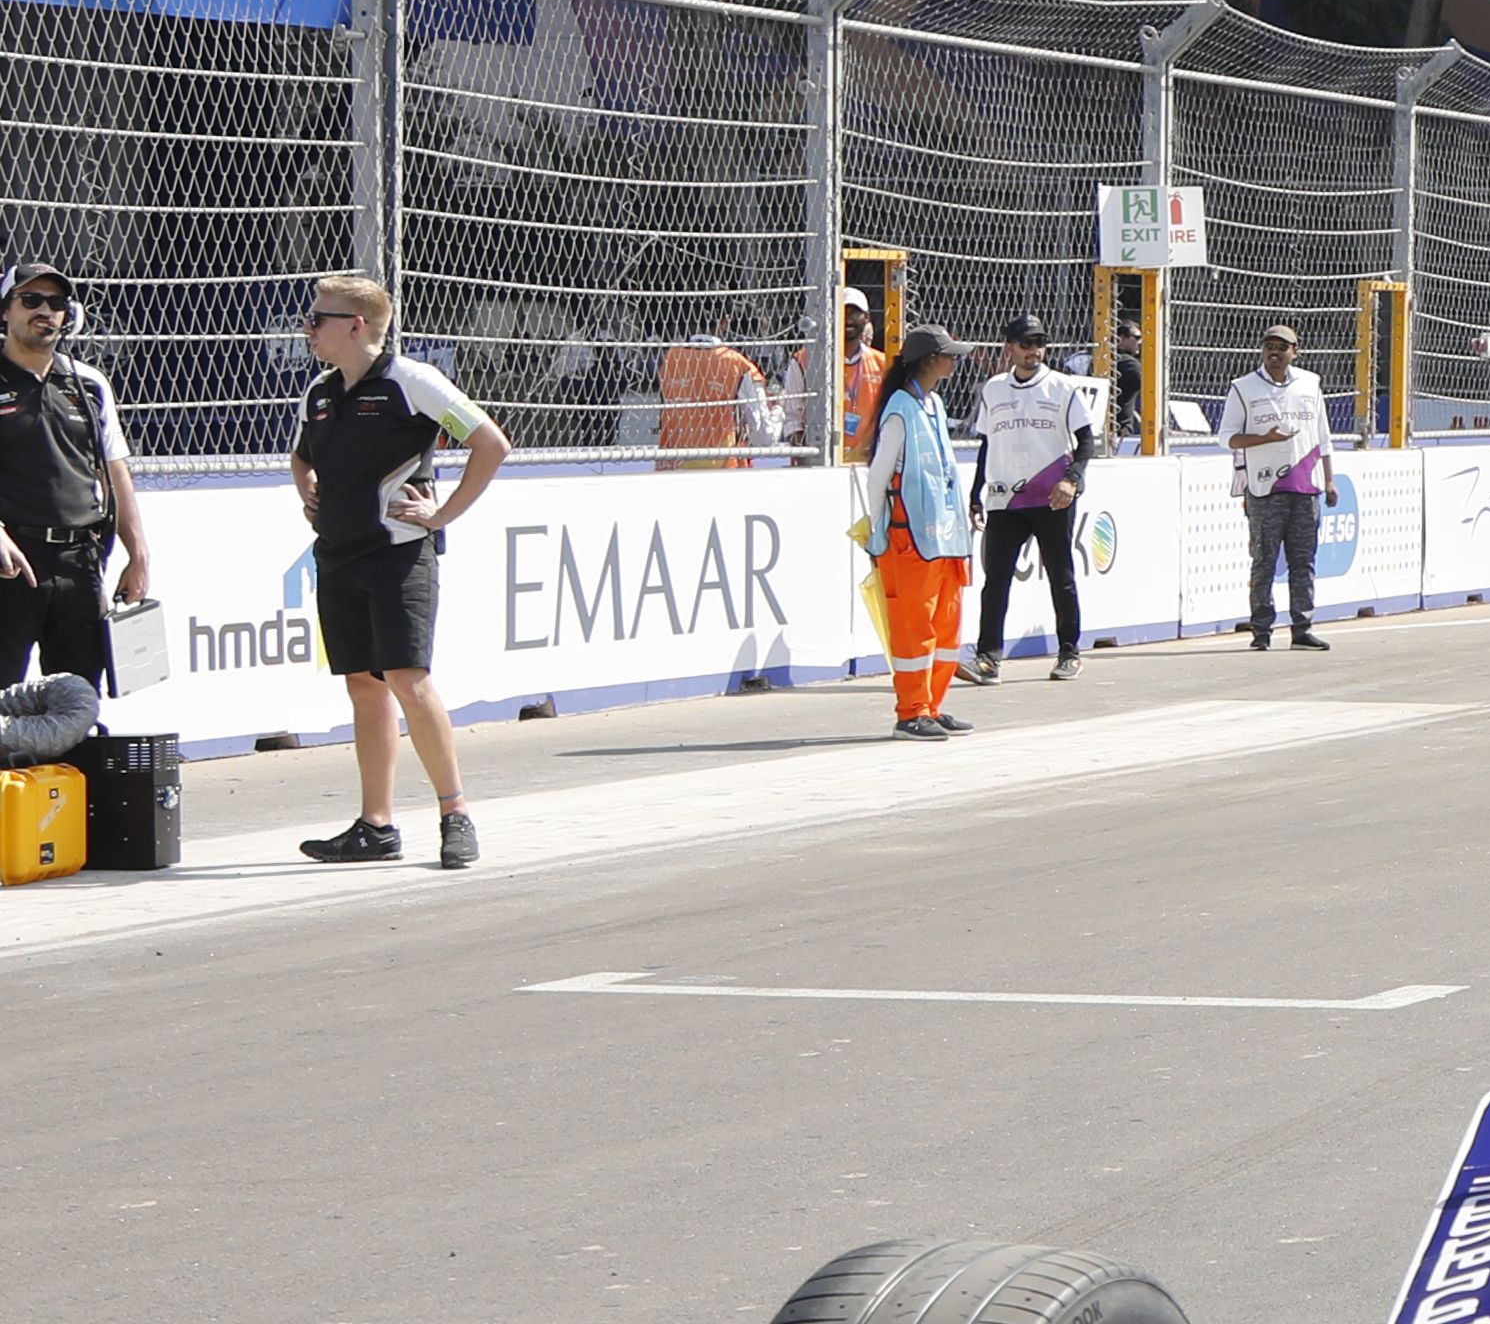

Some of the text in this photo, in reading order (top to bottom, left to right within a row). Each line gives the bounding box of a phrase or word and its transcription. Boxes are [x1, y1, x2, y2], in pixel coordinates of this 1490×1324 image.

[1121, 228, 1197, 243] EXIT IRE
[505, 514, 788, 652] EMAAR
[188, 609, 312, 674] hmda
